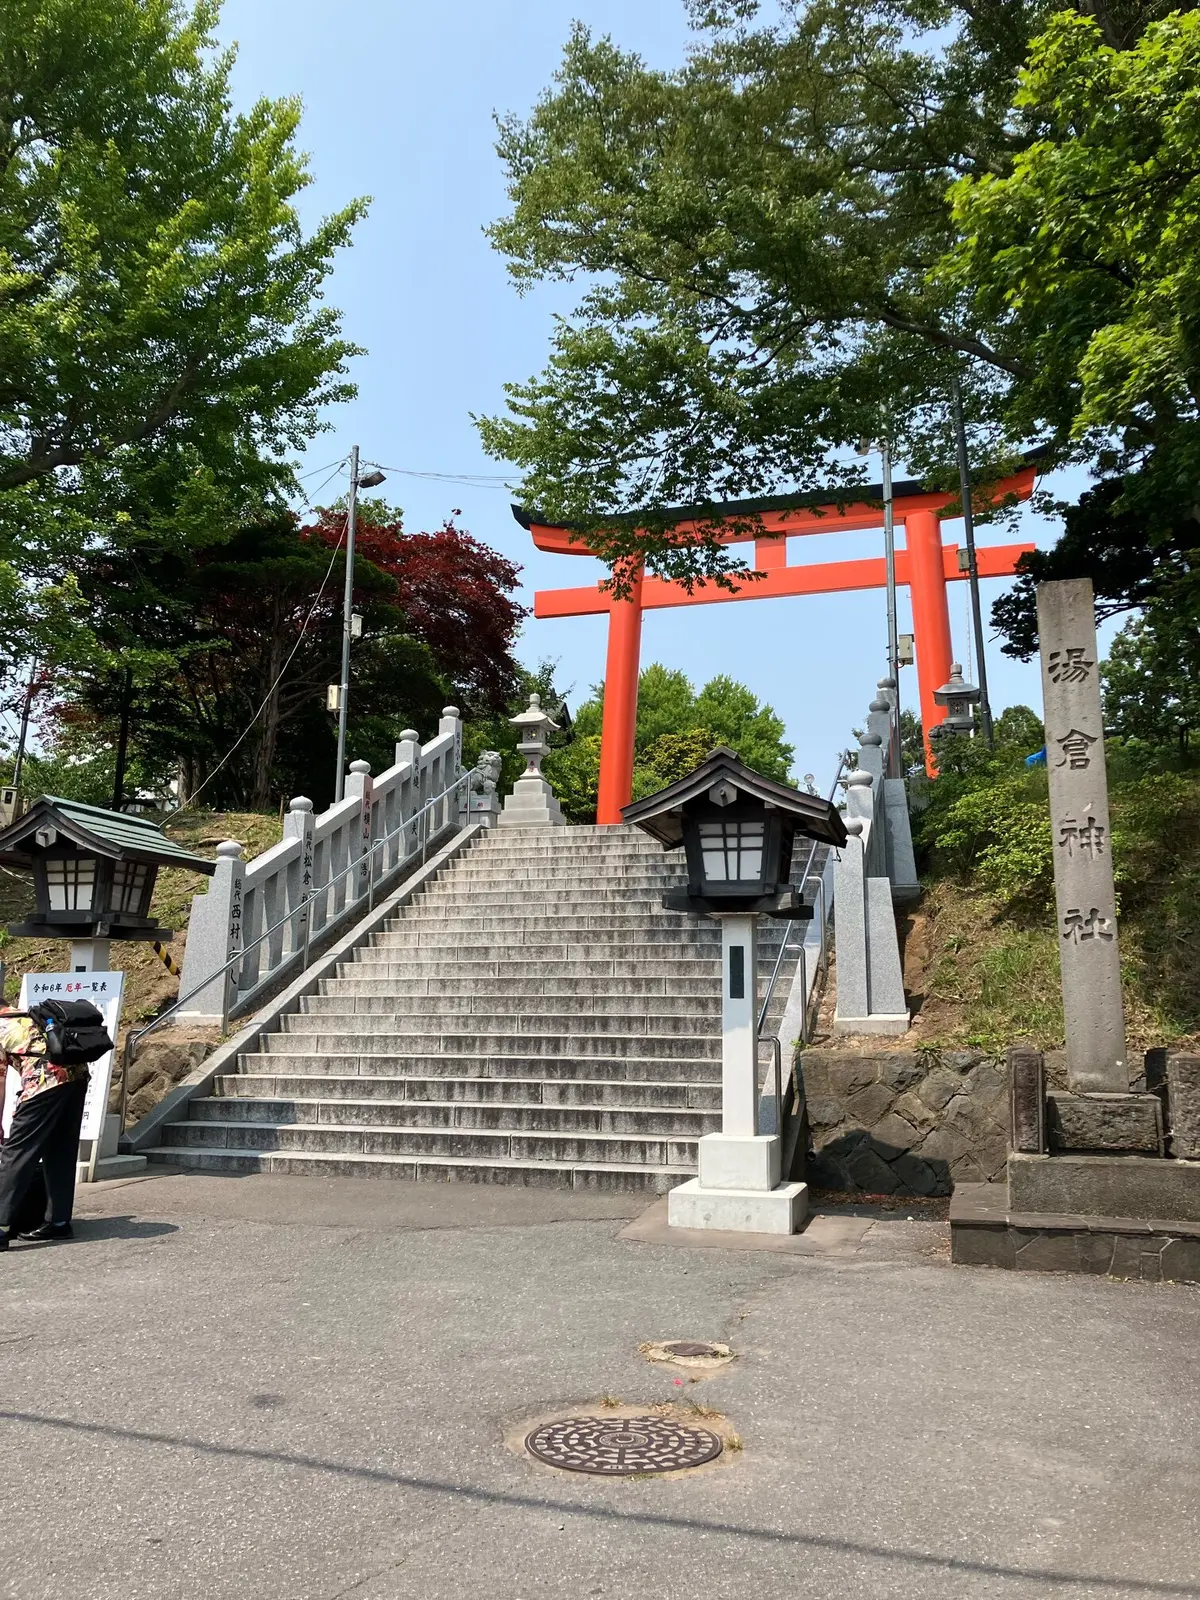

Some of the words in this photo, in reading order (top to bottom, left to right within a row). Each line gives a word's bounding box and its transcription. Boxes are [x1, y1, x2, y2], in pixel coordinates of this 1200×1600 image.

[1047, 647, 1114, 946] 湯倉神社
[228, 878, 242, 985] 総代西村
[33, 983, 63, 993] 令和6年
[65, 981, 108, 993] 厄年一覧表
